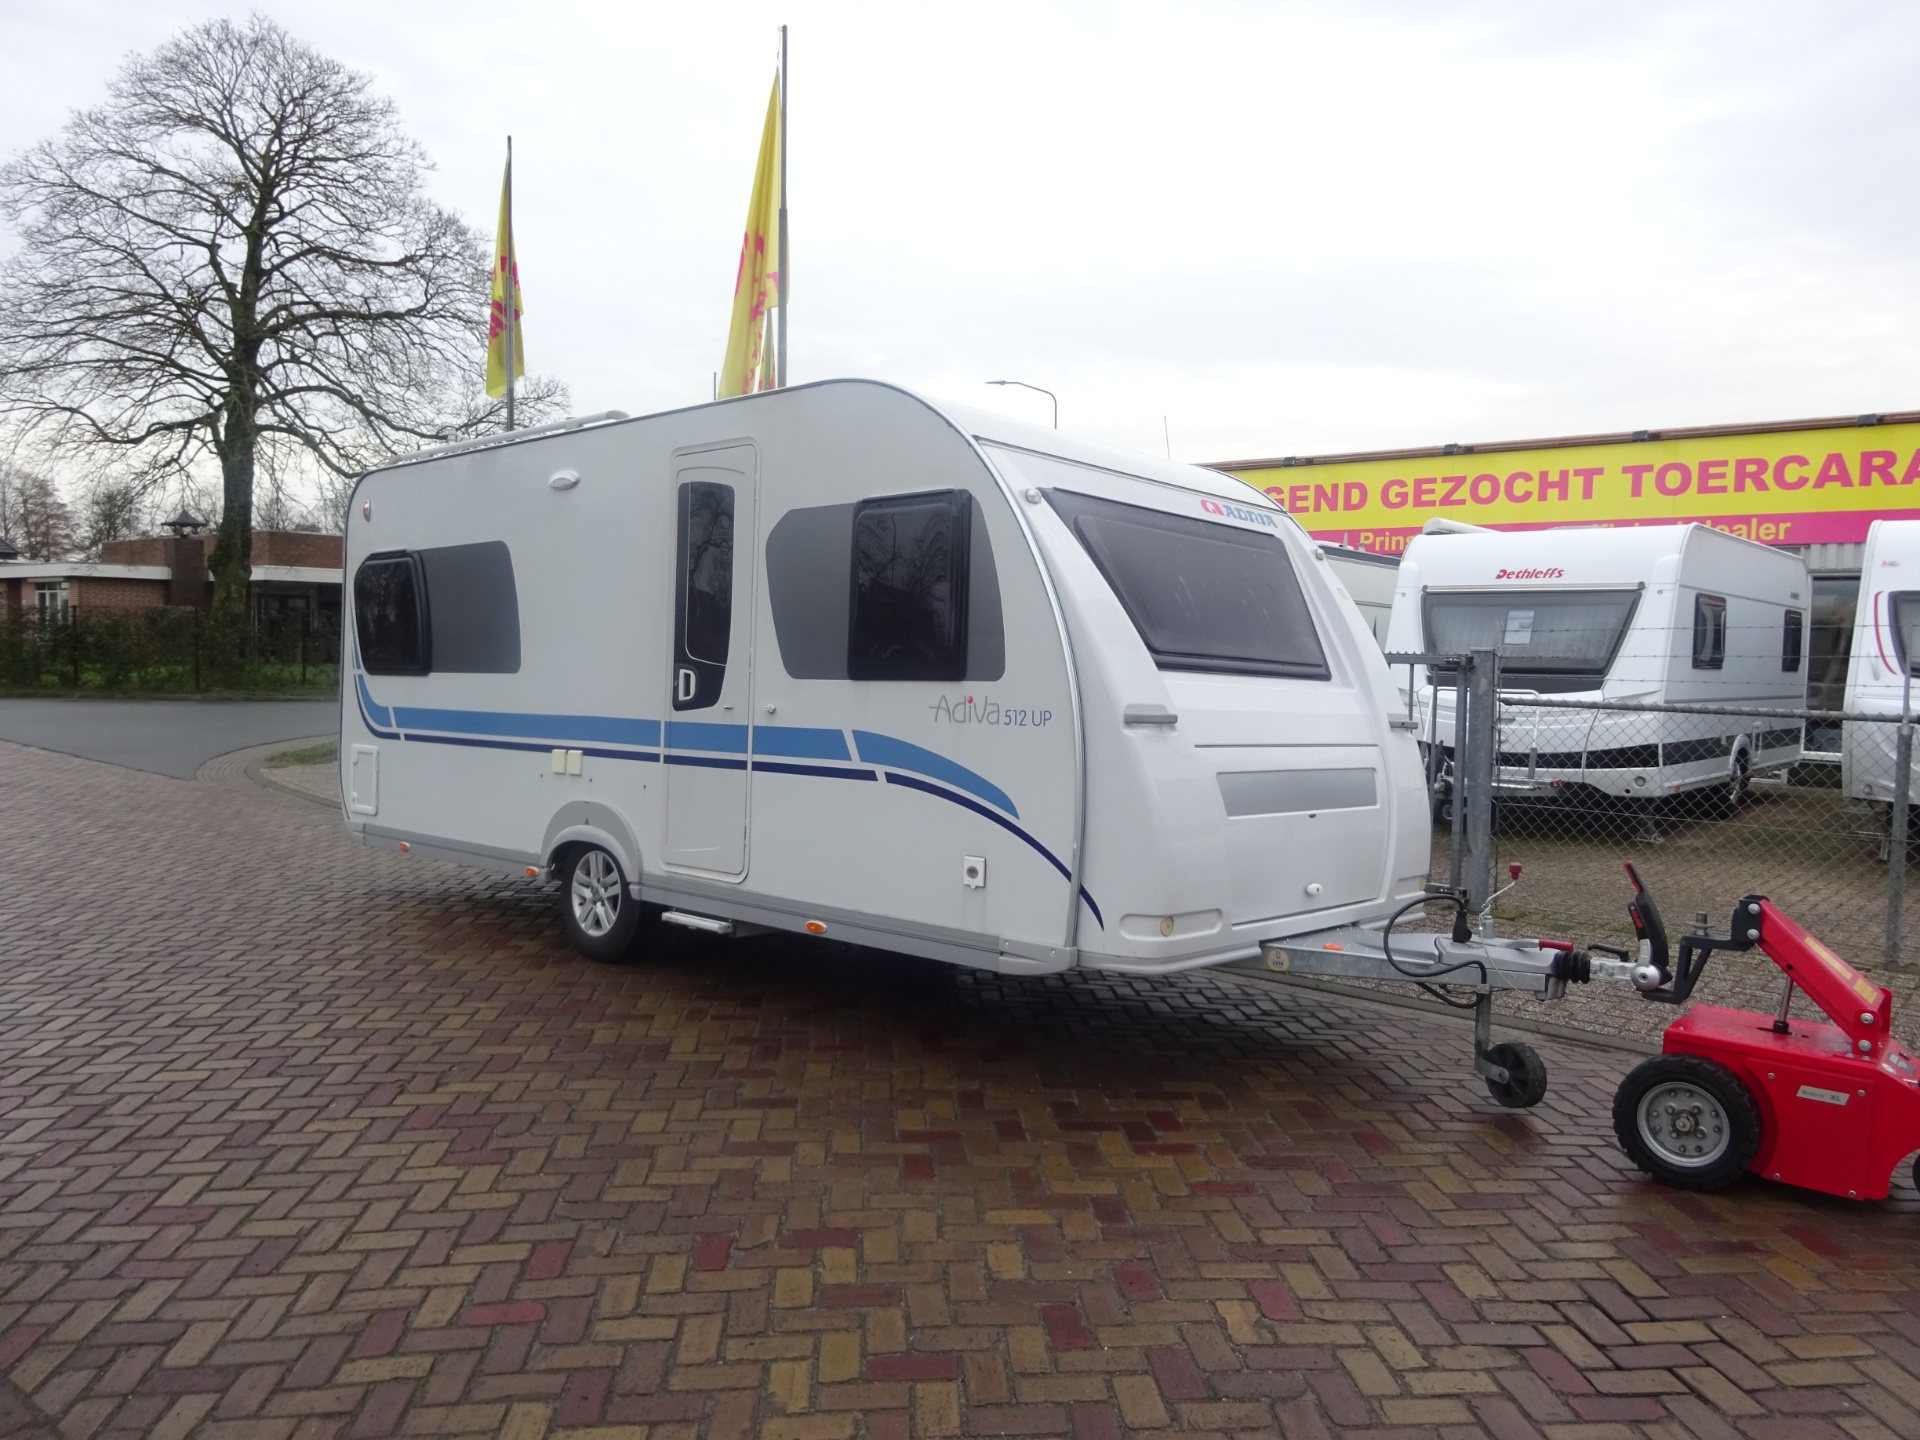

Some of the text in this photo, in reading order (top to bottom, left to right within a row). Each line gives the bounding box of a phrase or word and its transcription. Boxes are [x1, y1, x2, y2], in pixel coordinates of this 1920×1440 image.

[1380, 467, 1605, 510] GEZOCHT
[1222, 504, 1278, 528] ADRIA
[1495, 568, 1565, 579] Dethleffs
[1003, 709, 1027, 727] 512
[1031, 710, 1053, 727] UP
